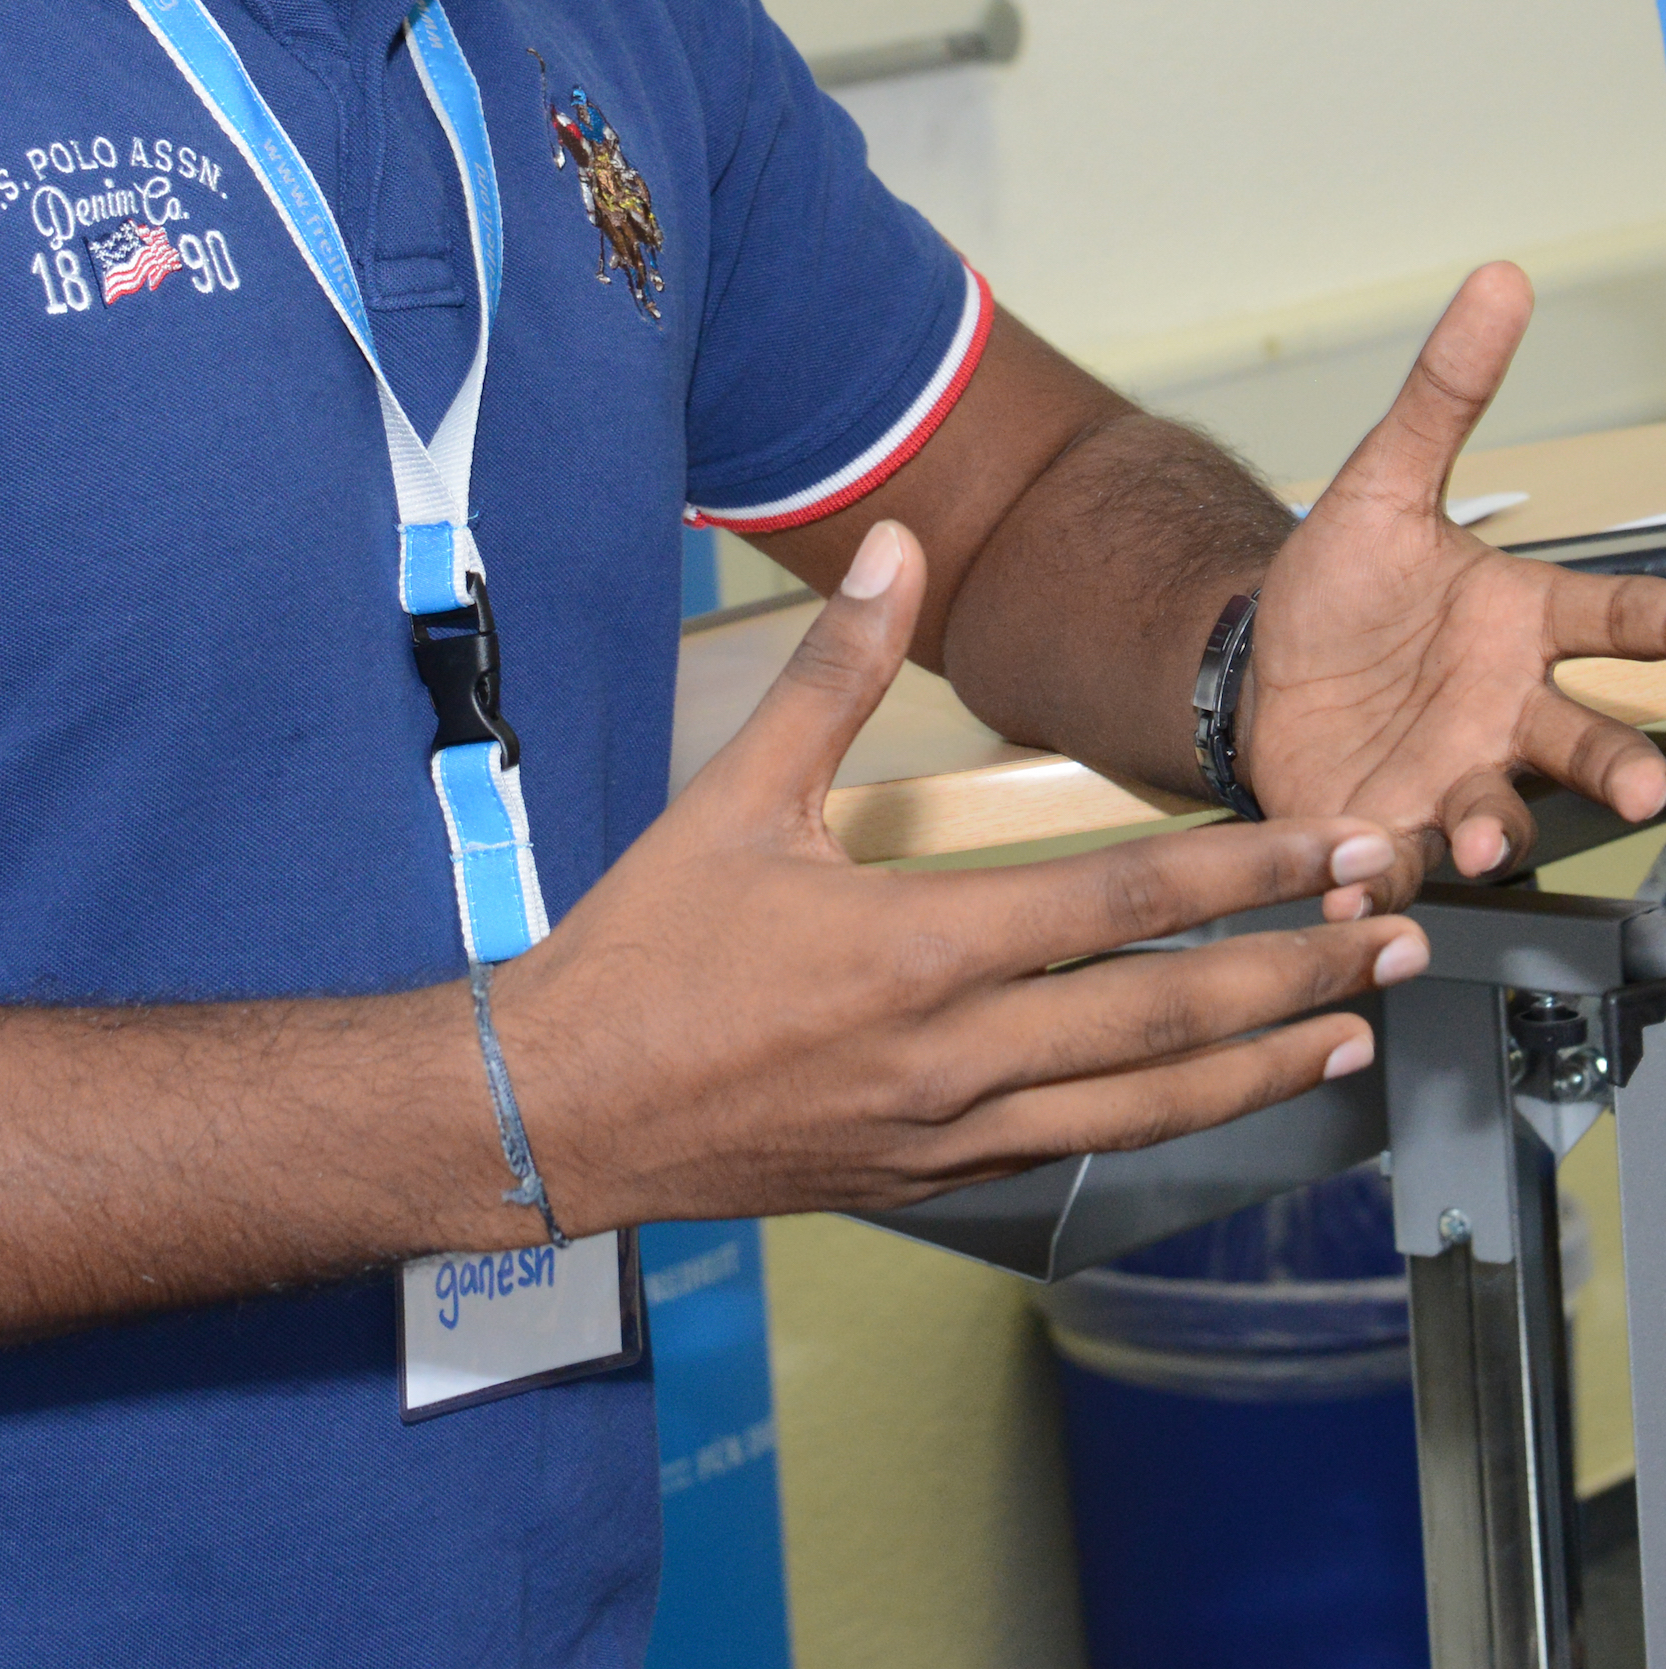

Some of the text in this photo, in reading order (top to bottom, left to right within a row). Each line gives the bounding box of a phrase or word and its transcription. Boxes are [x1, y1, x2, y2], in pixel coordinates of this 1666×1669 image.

[26, 136, 117, 181] POLO
[131, 137, 229, 200] ASSN.
[32, 176, 190, 251] Denim Co.
[32, 230, 240, 314] 18 90
